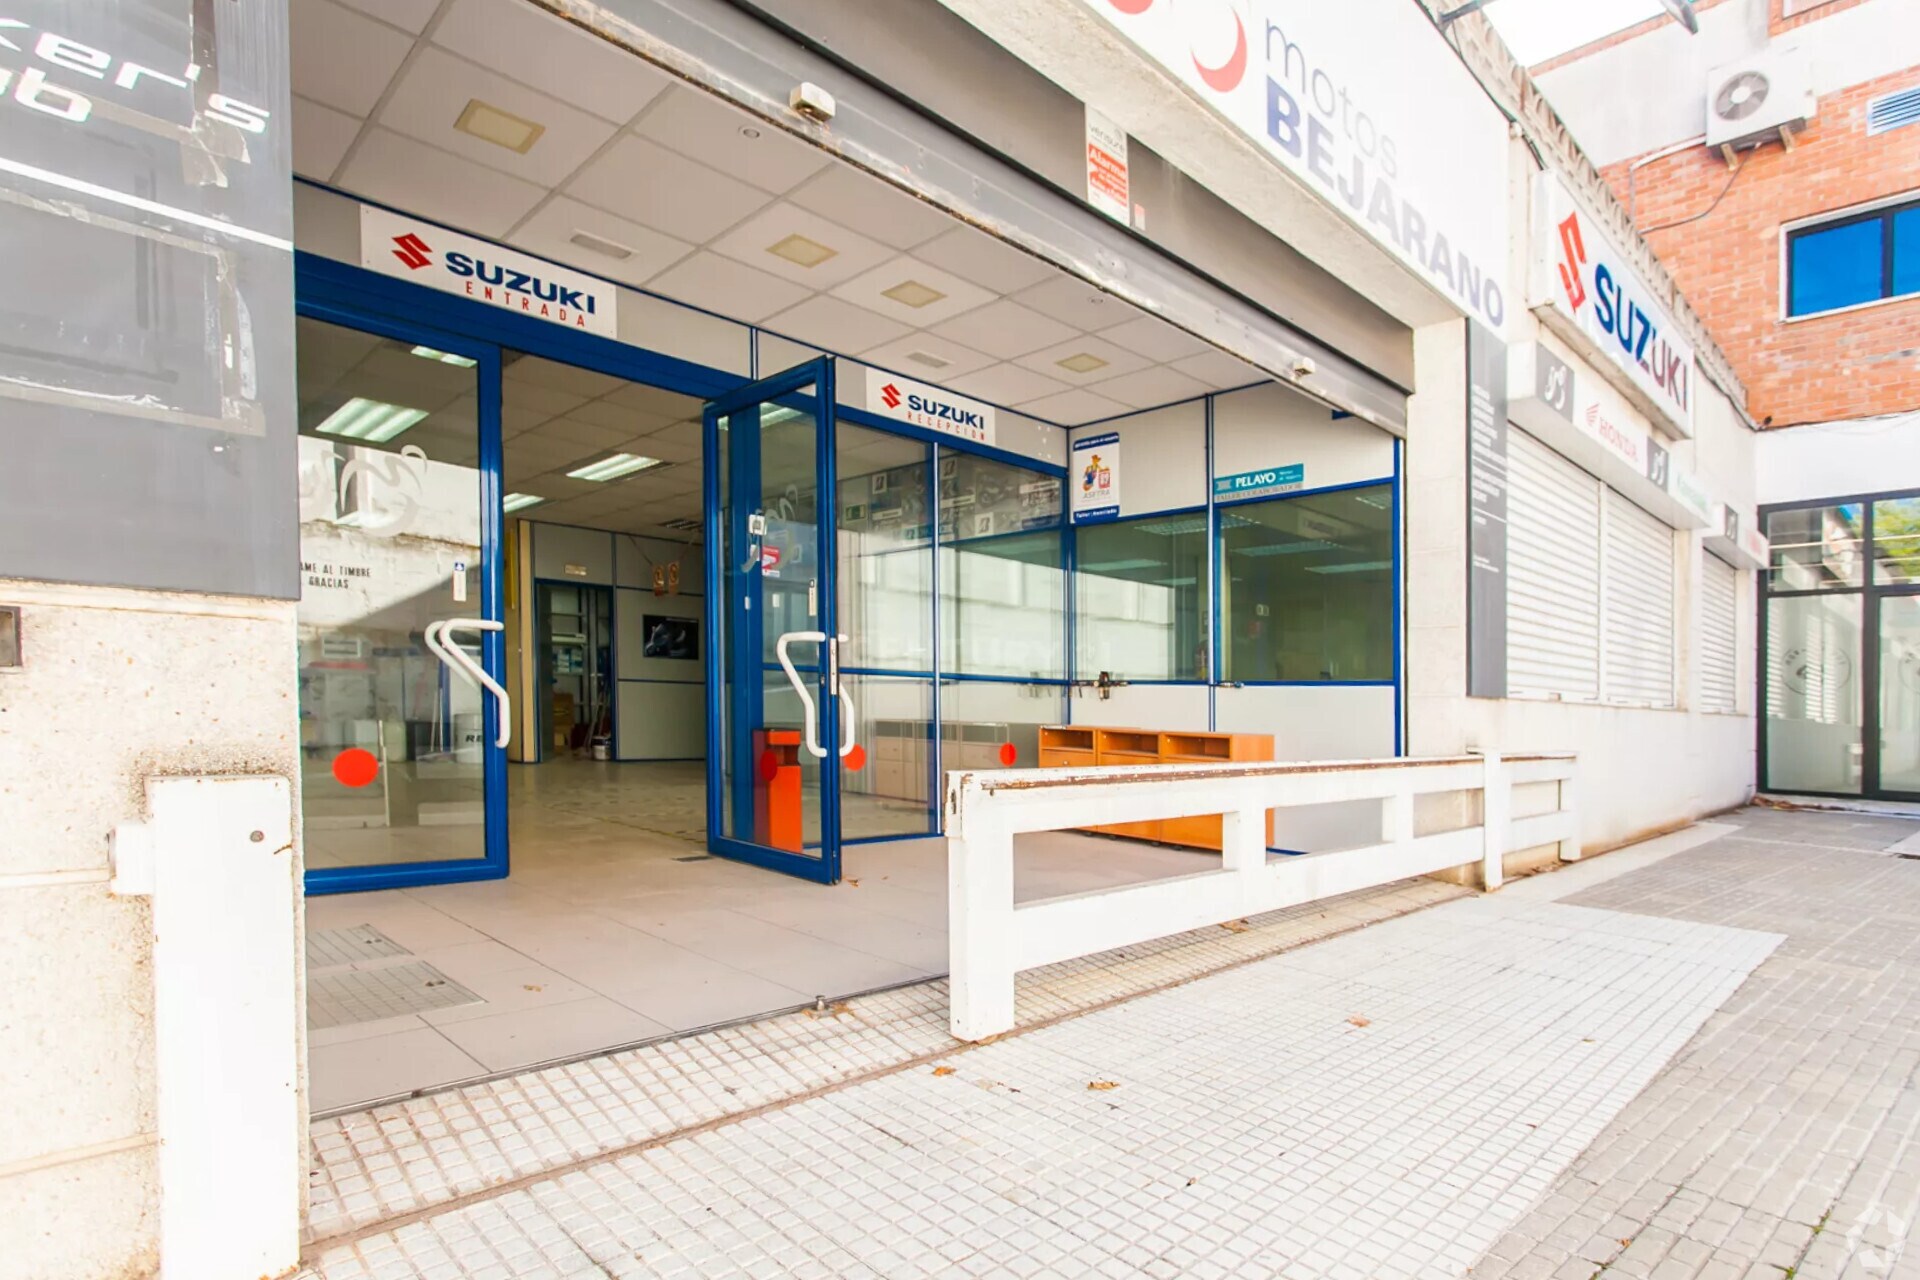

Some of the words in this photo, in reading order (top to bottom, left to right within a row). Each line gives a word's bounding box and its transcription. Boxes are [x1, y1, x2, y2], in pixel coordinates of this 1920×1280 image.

[1265, 17, 1398, 181] motos
[1266, 74, 1504, 328] BEJARANO
[445, 251, 596, 315] SUZUKI
[465, 280, 585, 327] ENTRADA
[1594, 263, 1687, 413] SUZUKI
[907, 394, 984, 430] SUZUKI
[1598, 416, 1640, 462] HONDA
[1235, 472, 1277, 488] PELAYO
[309, 576, 349, 589] GRACIAS
[323, 564, 333, 575] AL
[339, 565, 371, 577] TIMBRE
